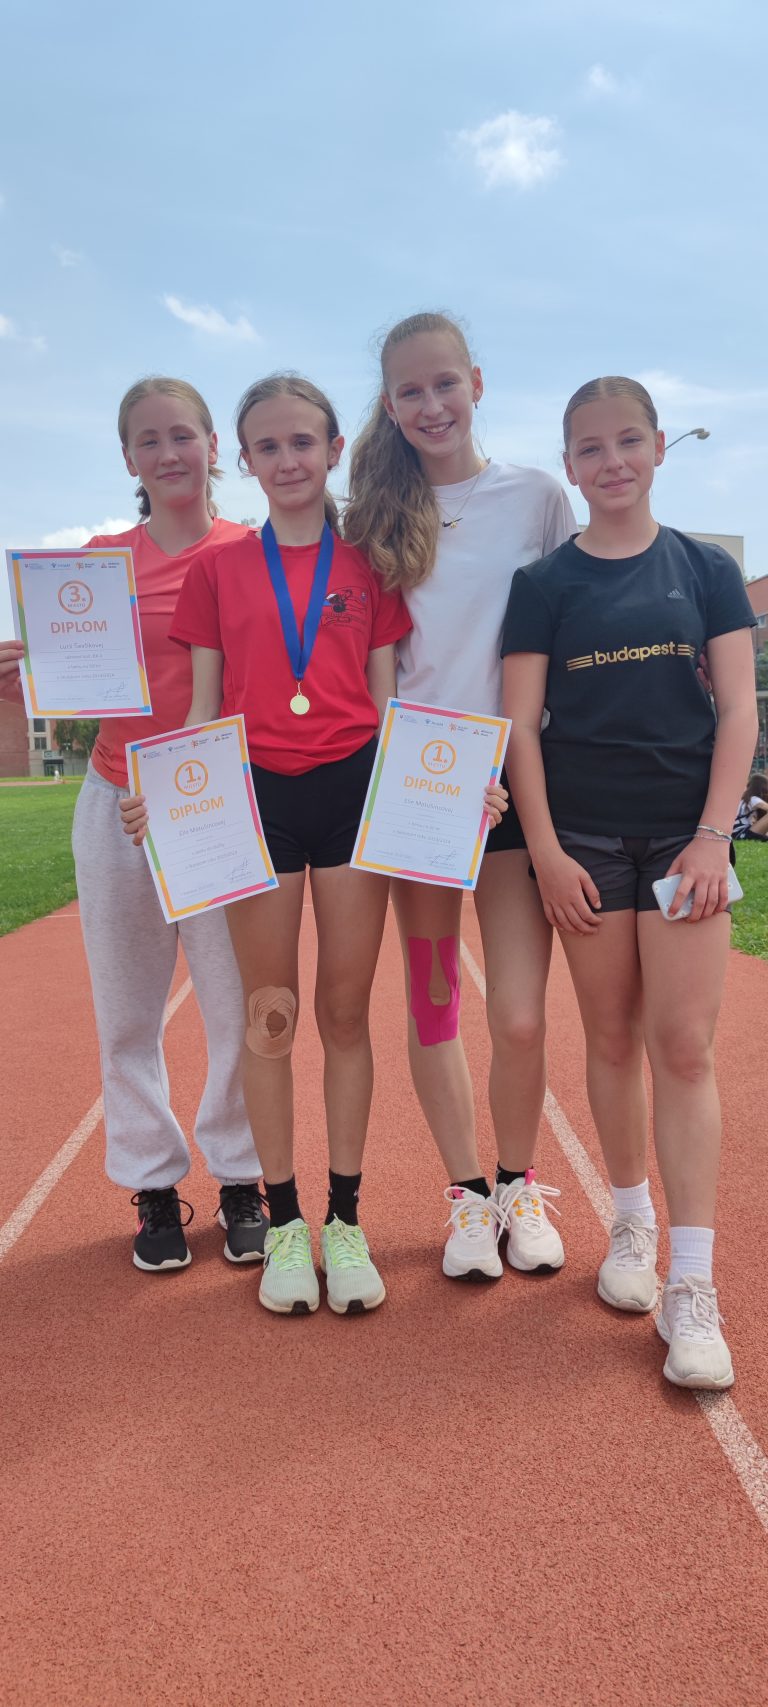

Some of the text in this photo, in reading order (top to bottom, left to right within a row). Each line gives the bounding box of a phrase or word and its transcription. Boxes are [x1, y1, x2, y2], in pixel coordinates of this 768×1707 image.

[68, 585, 86, 602] 3.
[50, 620, 108, 634] DIPLOM
[594, 641, 676, 665] budapest
[432, 745, 448, 764] 1.
[185, 765, 202, 784] 1.
[403, 775, 461, 797] DIPLOM
[169, 796, 225, 821] DIPLOM
